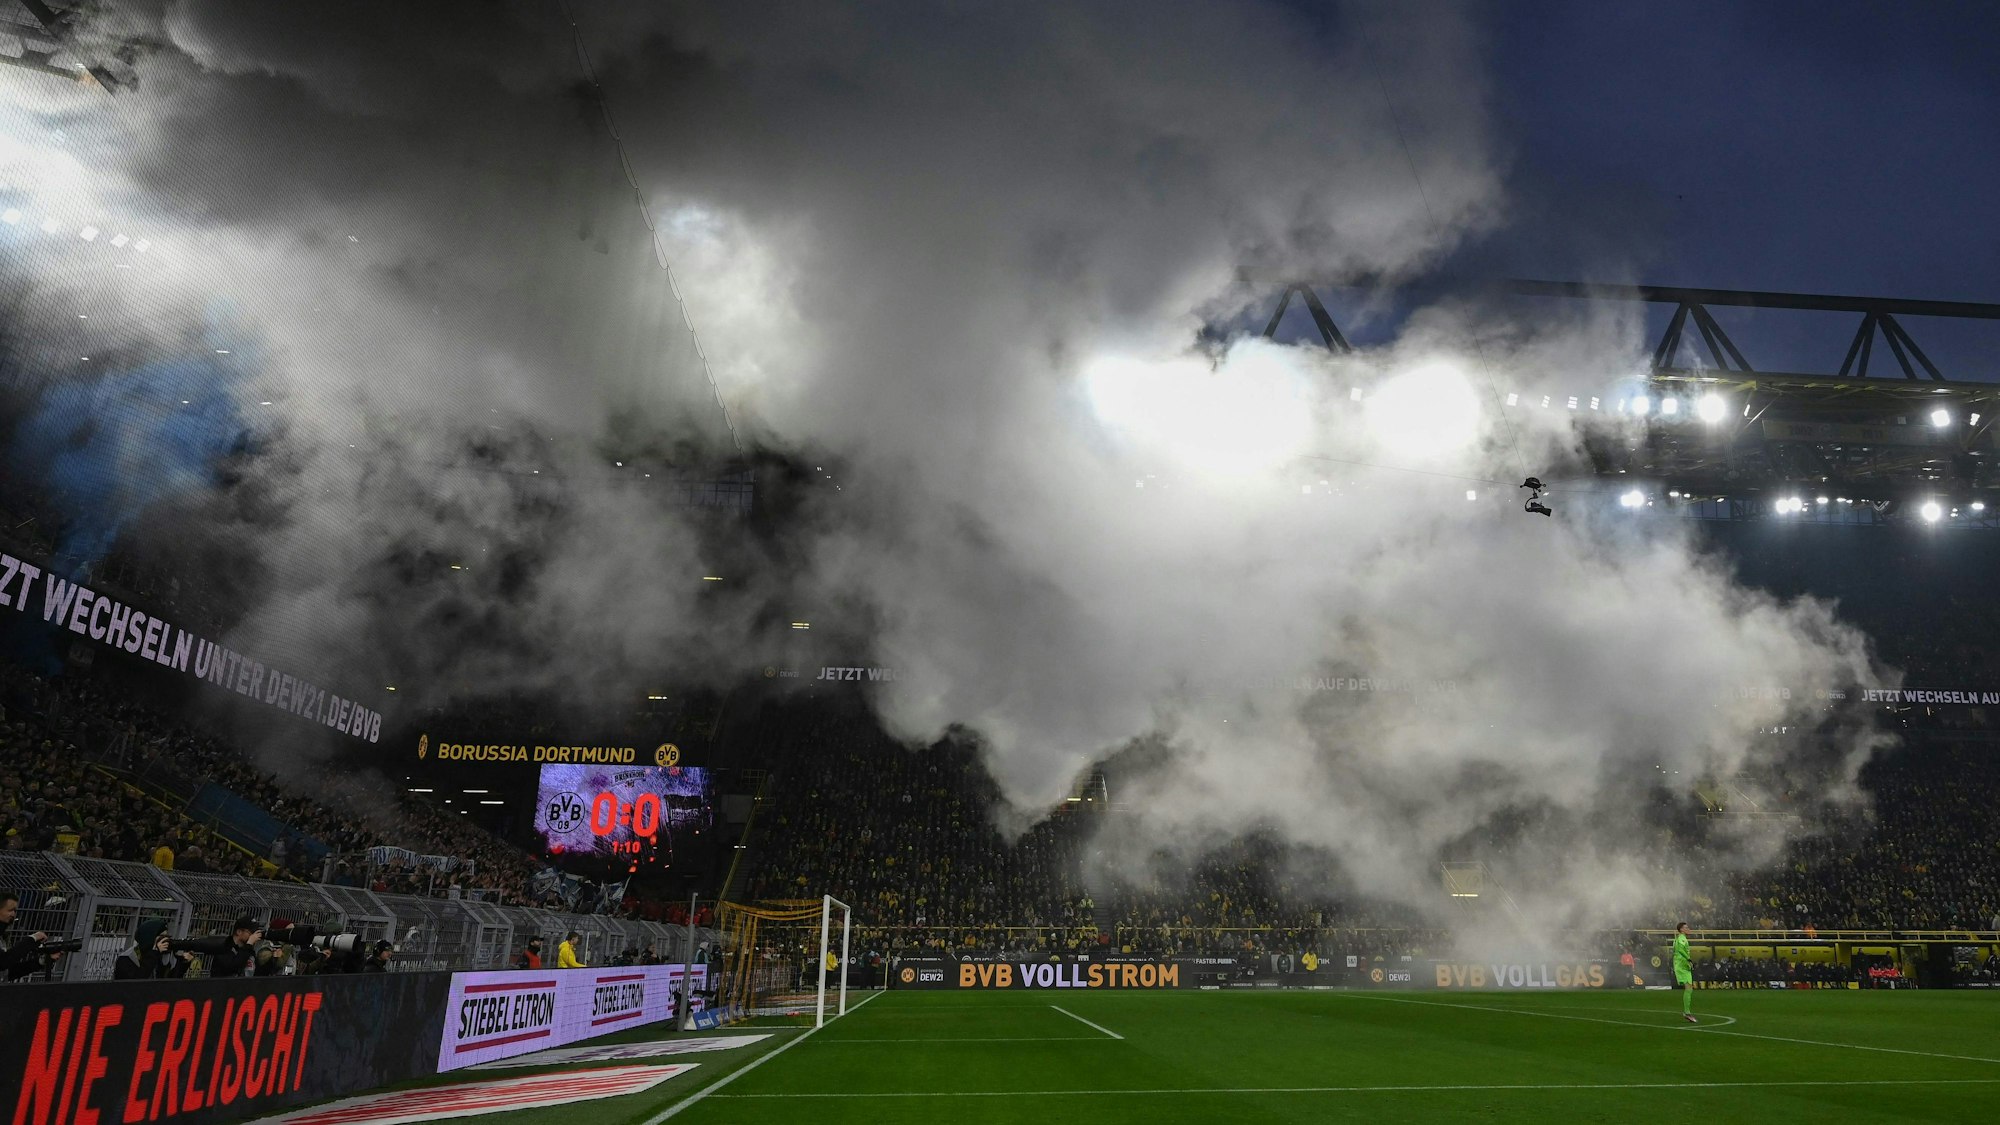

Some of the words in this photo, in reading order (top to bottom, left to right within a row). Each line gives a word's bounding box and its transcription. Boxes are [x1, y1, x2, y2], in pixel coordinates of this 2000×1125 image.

[43, 573, 193, 673] WECHSELN
[194, 638, 265, 700] UNTER
[265, 669, 382, 744] DEW21.DE/BVB
[816, 667, 865, 681] JETZT
[1316, 678, 1345, 691] AUF
[1861, 689, 1900, 702] JETZT
[1903, 690, 1979, 704] WECHSELN
[1981, 692, 2000, 704] AU
[438, 743, 529, 762] BORUSSIA
[533, 745, 636, 763] DORTMUND
[658, 746, 677, 760] BVB
[550, 795, 582, 821] BVB
[590, 791, 661, 837] 0:0
[557, 820, 570, 830] 09
[612, 840, 642, 854] 1:10
[959, 963, 1013, 987] BVB
[1019, 963, 1179, 987] VOLLSTROM
[1435, 964, 1486, 988] BVB
[1491, 964, 1605, 988] VOLLGAS
[592, 985, 620, 1016] STIEBEL
[620, 983, 644, 1010] ELTRON
[457, 996, 509, 1039] STIEBEL
[511, 992, 556, 1030] ELTRON
[11, 1004, 124, 1125] NIE
[122, 992, 323, 1124] ERLISCHT
